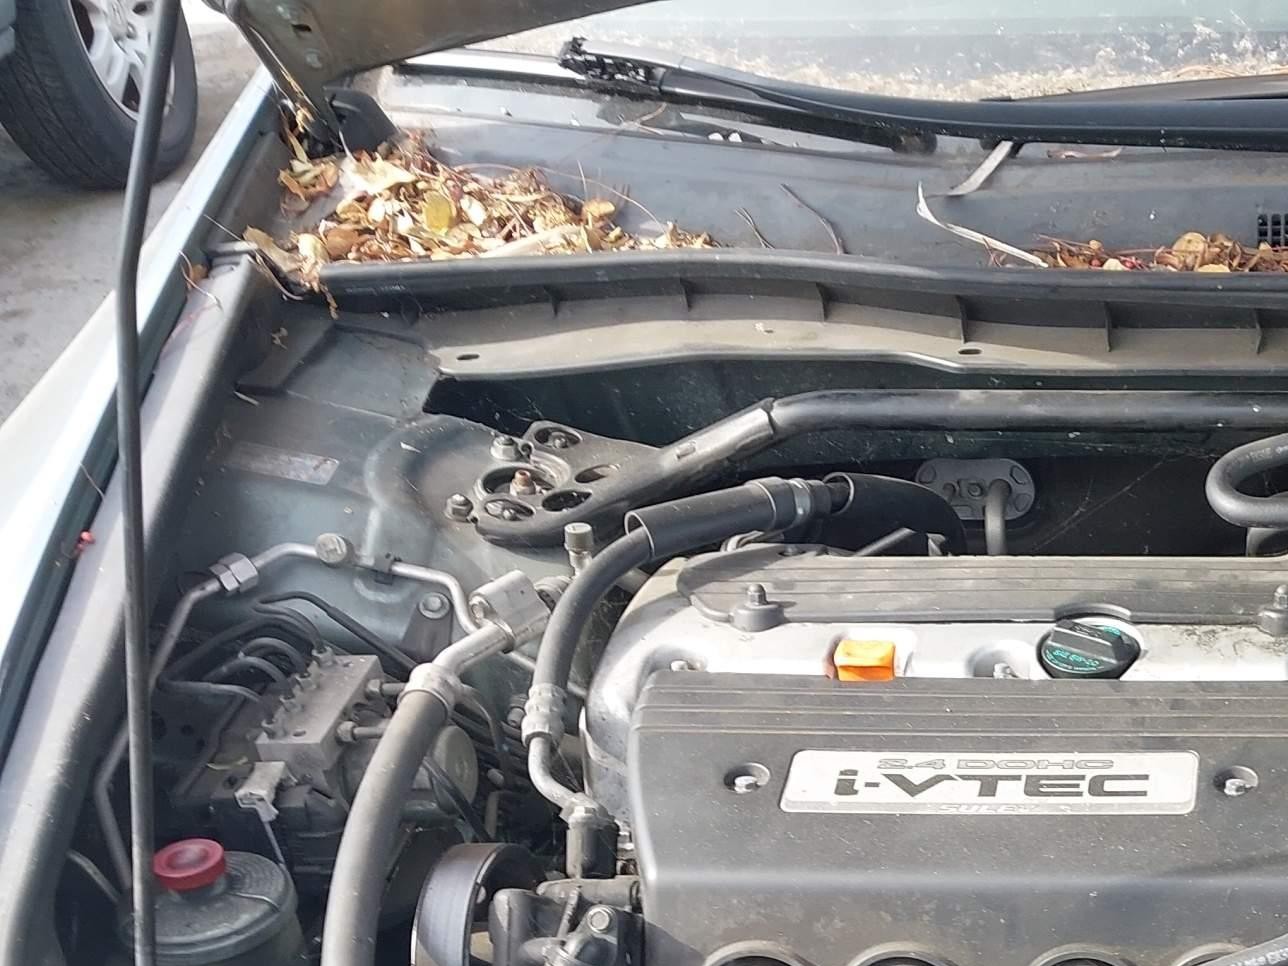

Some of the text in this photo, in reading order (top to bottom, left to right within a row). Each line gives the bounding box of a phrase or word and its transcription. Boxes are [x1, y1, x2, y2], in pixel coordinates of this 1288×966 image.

[877, 758, 1114, 770] 2.4 DOHC
[834, 769, 1150, 798] i-VTEC
